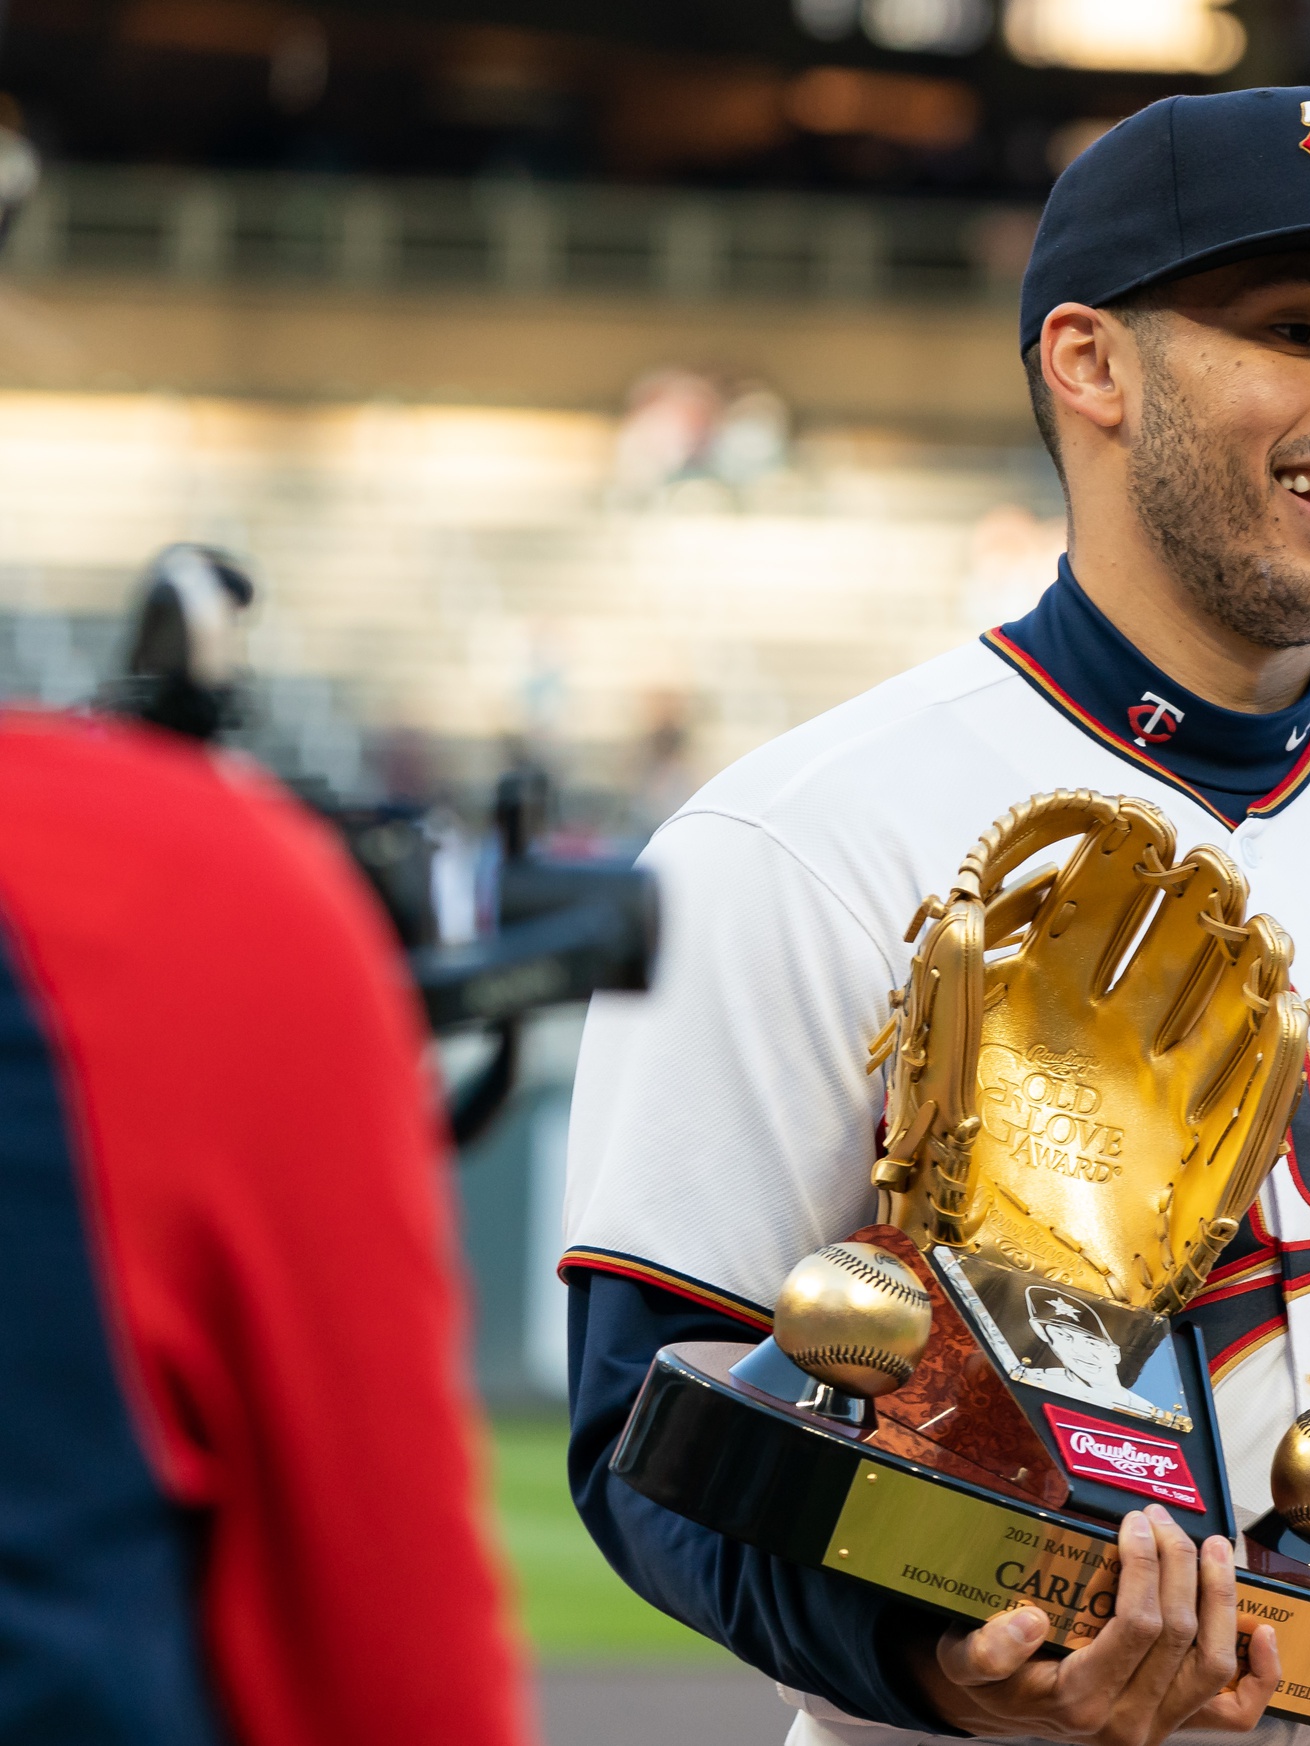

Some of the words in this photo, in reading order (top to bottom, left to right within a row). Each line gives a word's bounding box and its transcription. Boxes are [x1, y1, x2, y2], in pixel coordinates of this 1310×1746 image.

[1070, 1431, 1178, 1477] Rawlings
[1004, 1526, 1040, 1549] 2021
[1043, 1537, 1122, 1576] RAWLING
[900, 1563, 1002, 1609] HONORING
[994, 1560, 1117, 1620] CARLO
